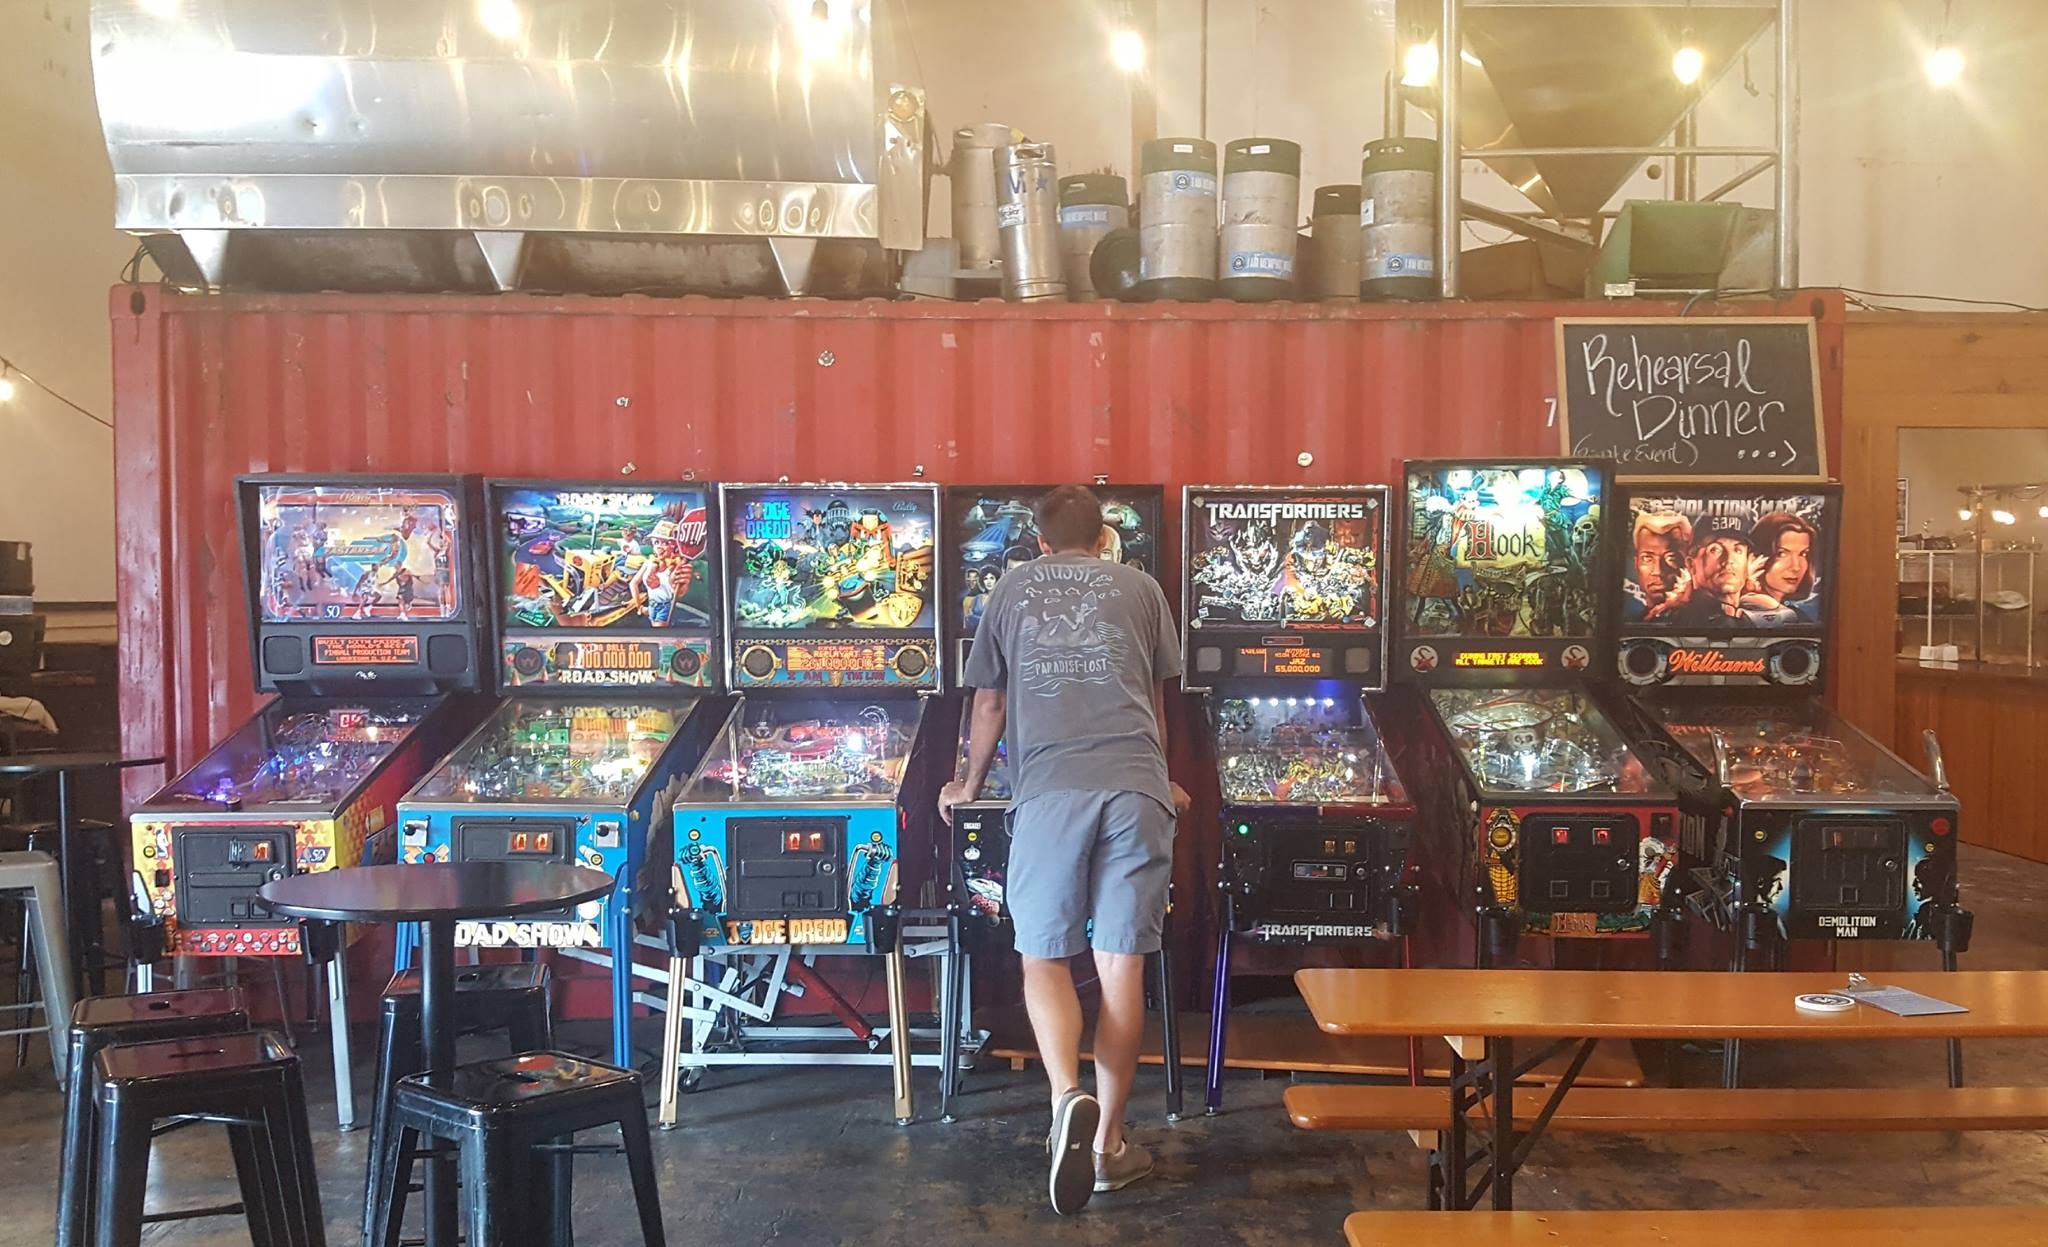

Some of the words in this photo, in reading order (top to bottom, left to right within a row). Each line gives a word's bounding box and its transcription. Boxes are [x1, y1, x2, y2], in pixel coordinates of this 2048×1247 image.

[1583, 334, 1766, 417] Rehearsal
[1633, 395, 1785, 440] Dinner
[1635, 438, 1699, 466] Event)
[559, 492, 603, 506] ROAD
[1760, 500, 1799, 513] MAN
[1206, 503, 1364, 527] TRANSFORMERS
[680, 521, 707, 545] STOP
[746, 520, 792, 539] DREDD
[1466, 519, 1541, 561] Hook
[1669, 650, 1766, 673] Williams
[561, 670, 606, 684] ROAD
[609, 670, 654, 686] SHOW
[789, 919, 847, 945] DREDD
[1818, 916, 1877, 927] DEMOLITION
[1836, 927, 1858, 937] MAN
[514, 922, 585, 947] SHOW
[1262, 925, 1373, 942] TRANSFORMERS
